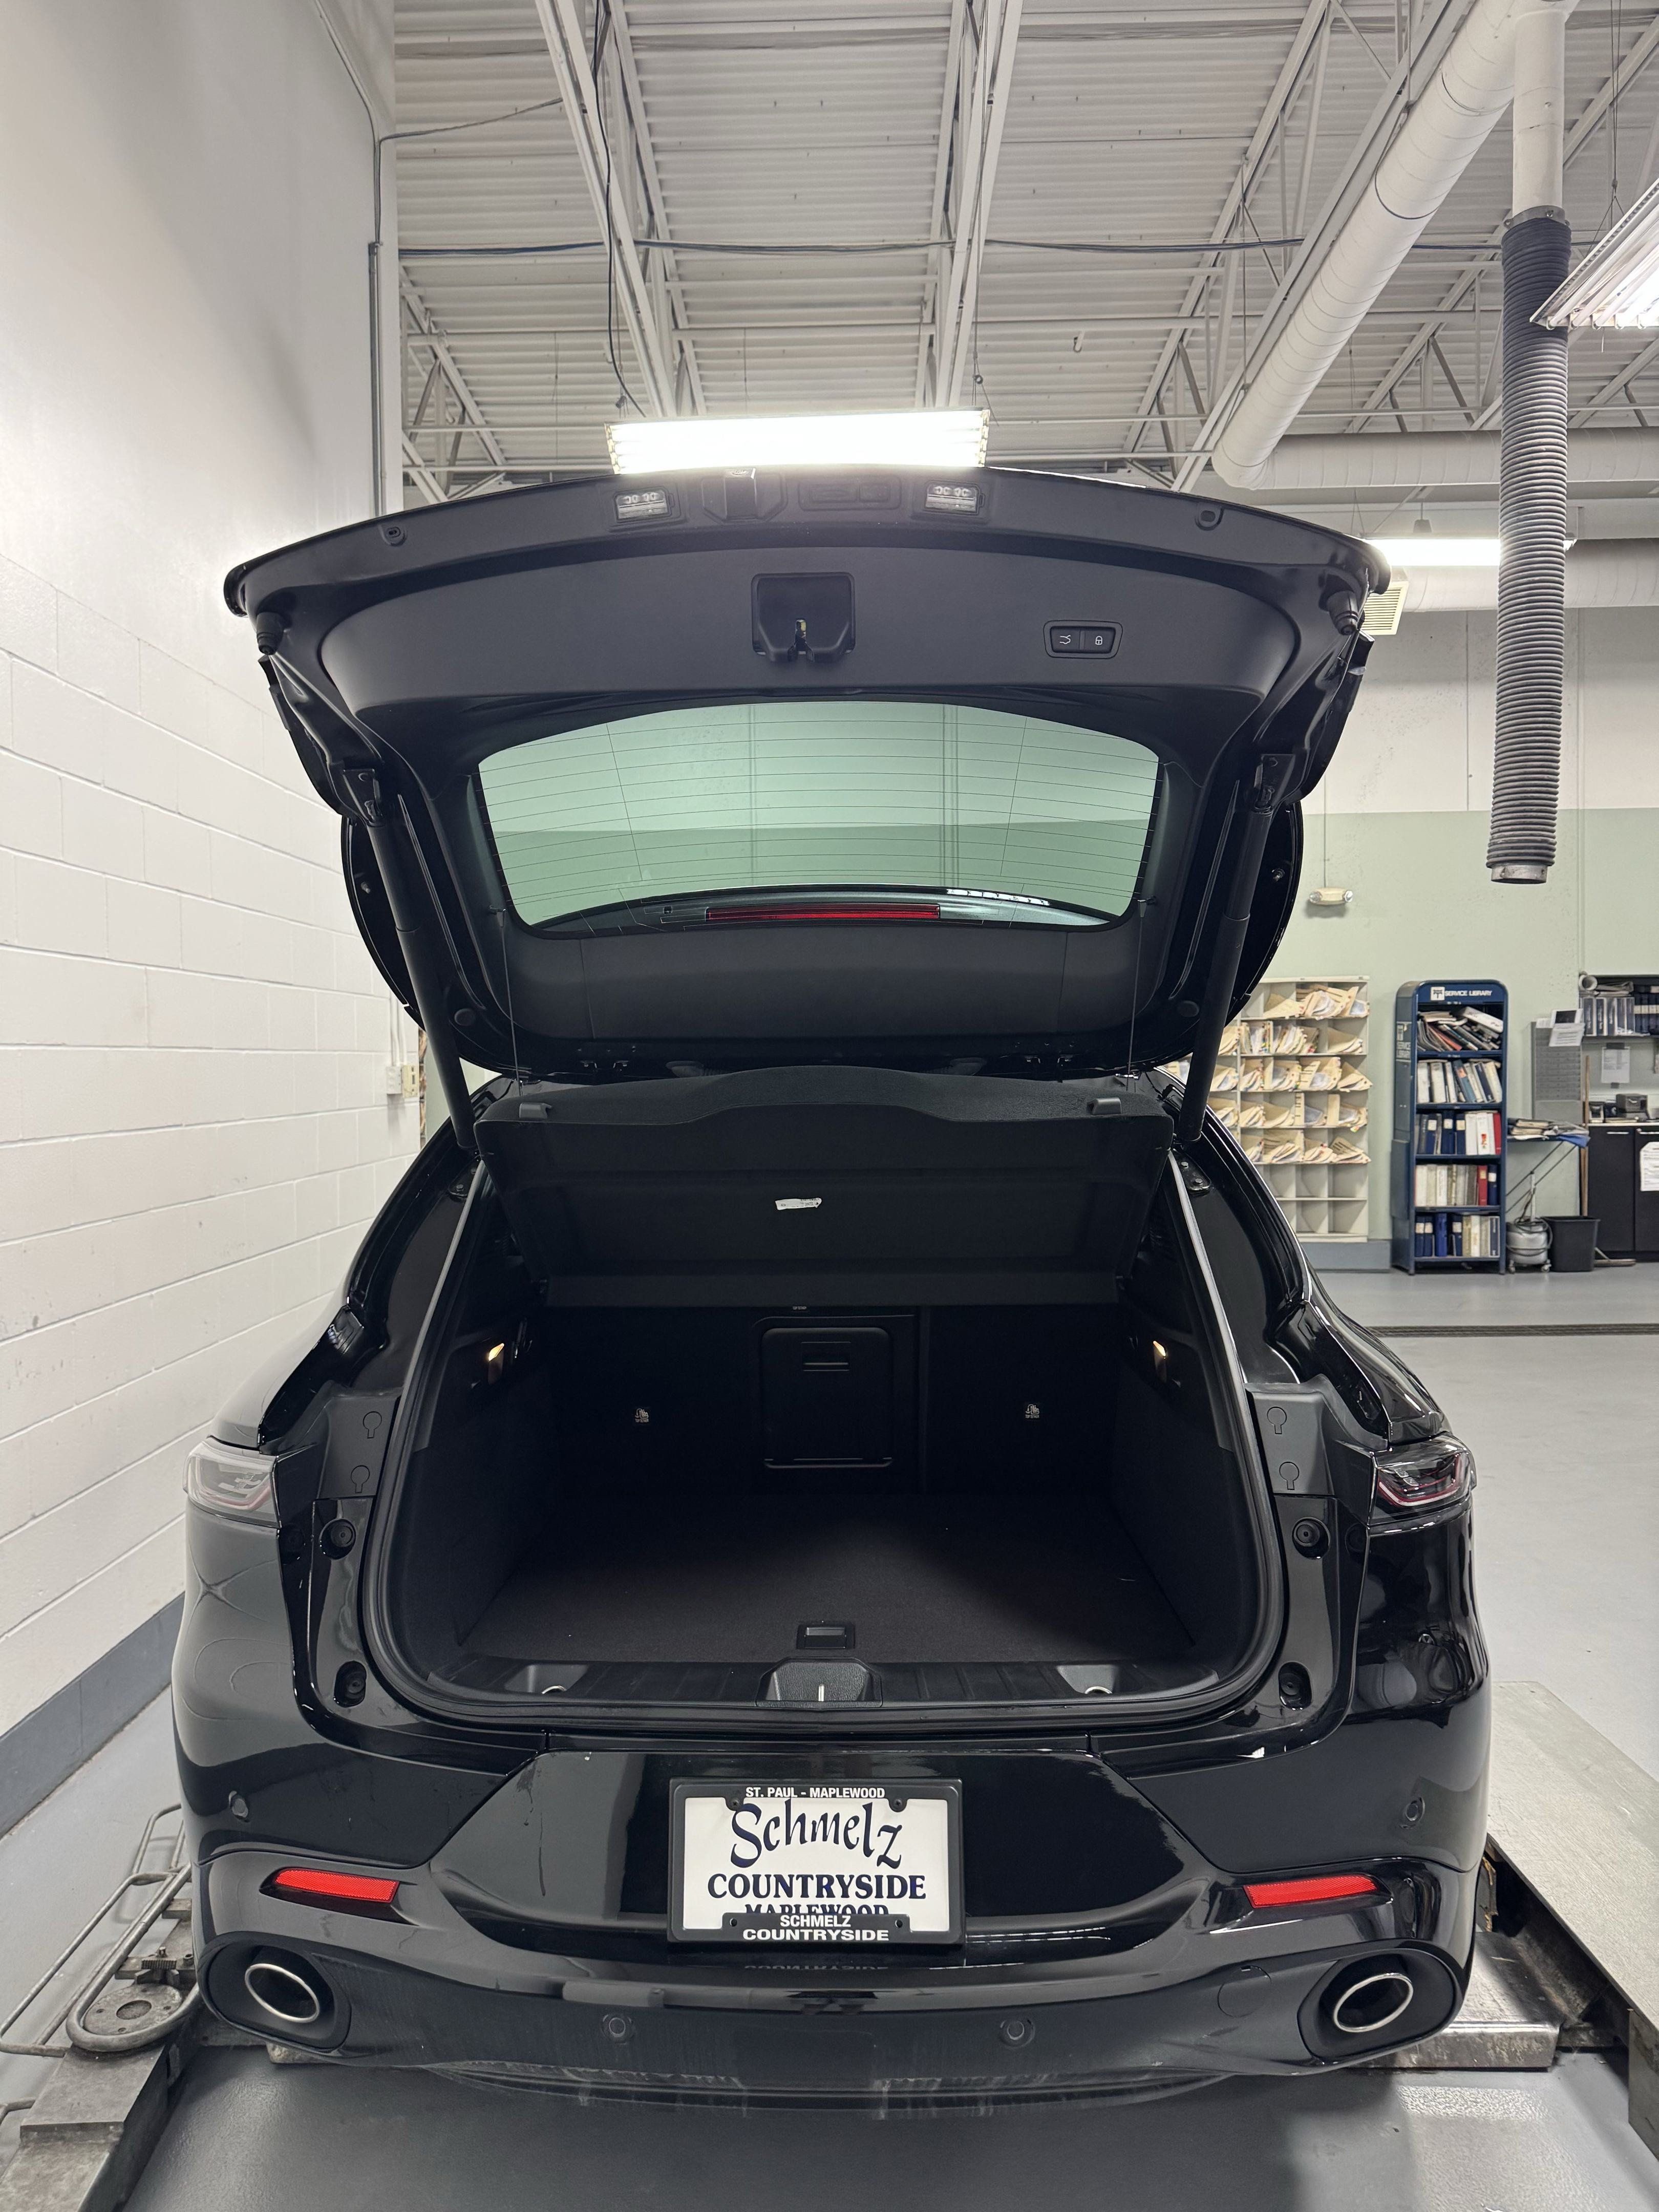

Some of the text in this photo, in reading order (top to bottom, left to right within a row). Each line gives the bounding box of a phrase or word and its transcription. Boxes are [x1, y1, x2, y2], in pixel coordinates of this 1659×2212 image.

[746, 1786, 764, 1797] ST.
[767, 1787, 798, 1798] PAUL
[810, 1787, 885, 1798] MAPLEWOOD
[730, 1799, 903, 1869] Schmelz
[708, 1873, 926, 1899] COUNTRYSIDE
[780, 1915, 851, 1927] SCHMELZ
[743, 1929, 889, 1941] COUNTRYSIDE
